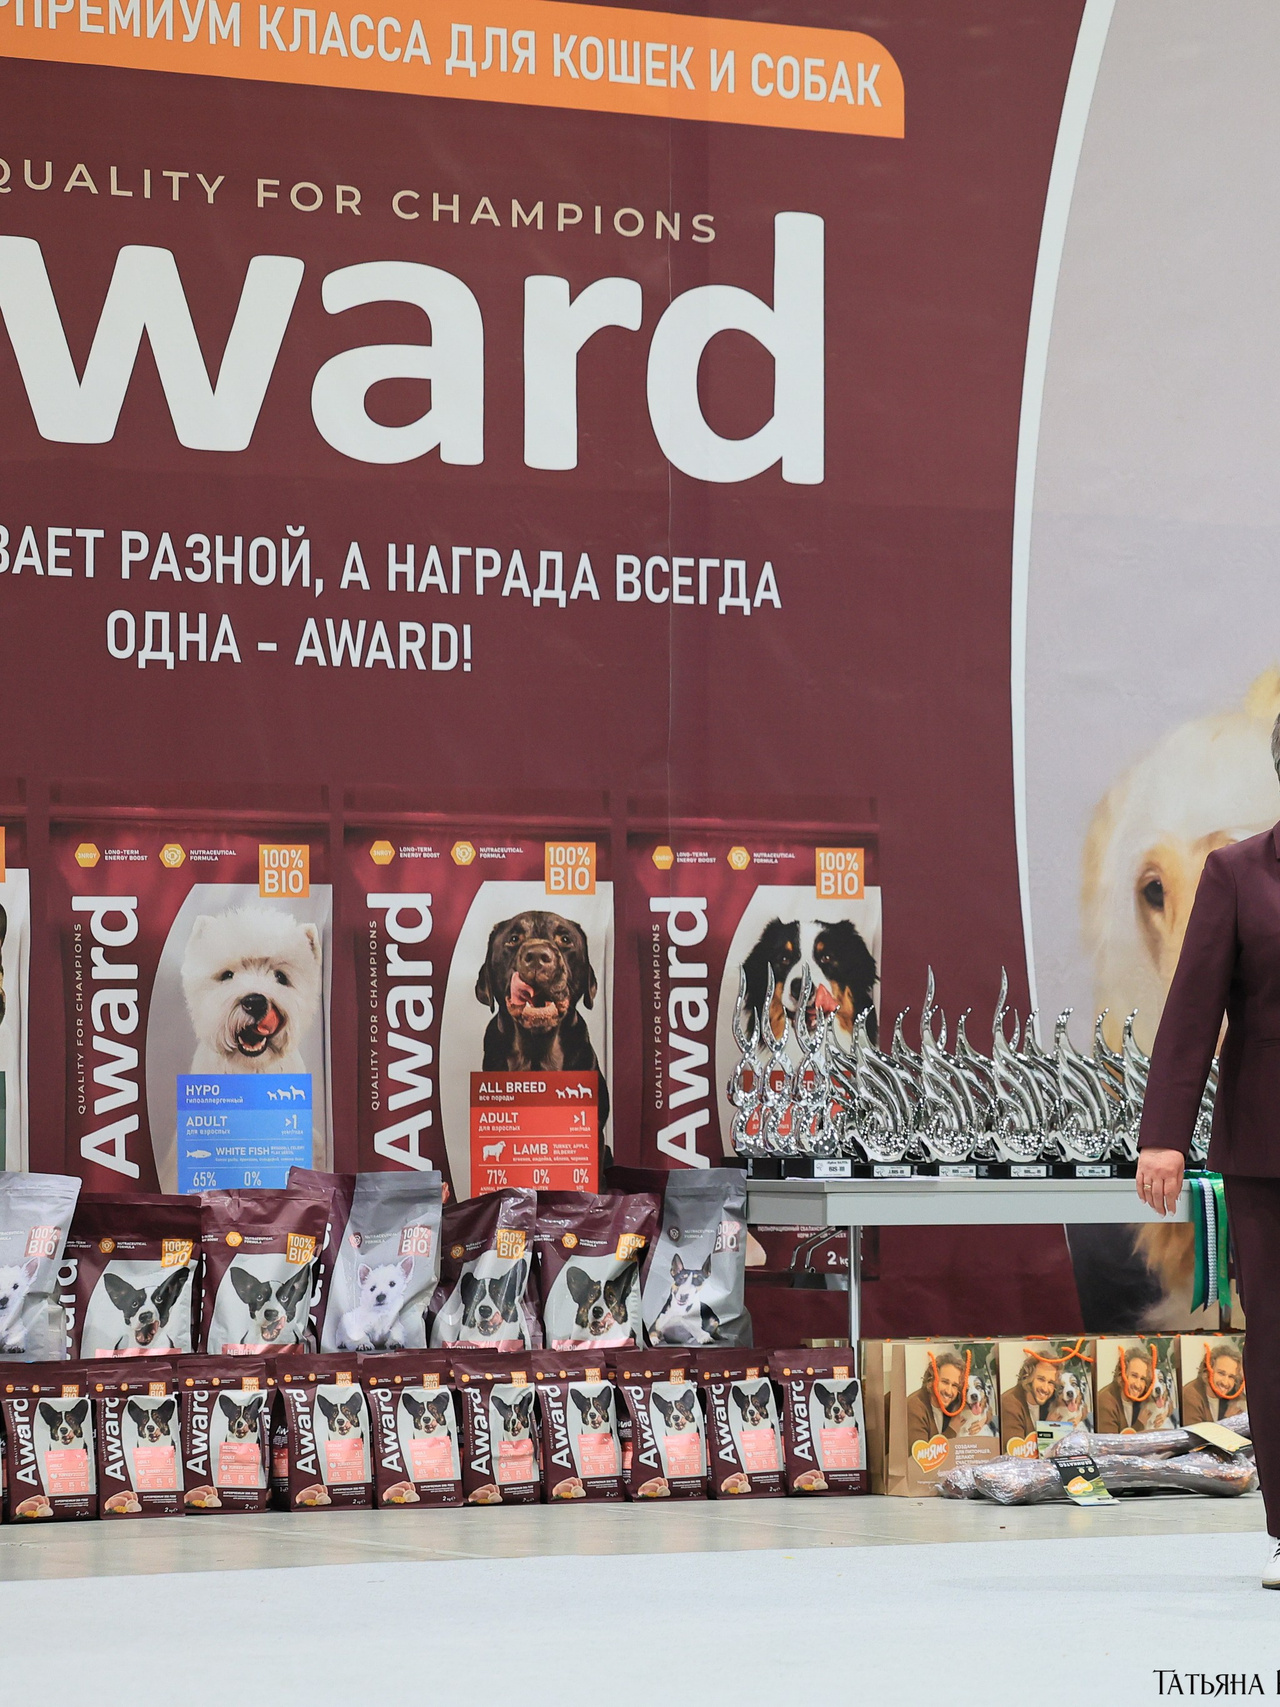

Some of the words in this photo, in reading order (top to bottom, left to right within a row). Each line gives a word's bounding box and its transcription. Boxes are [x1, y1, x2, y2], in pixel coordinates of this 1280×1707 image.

[0, 0, 240, 47] ПРЕМИУМ
[259, 5, 431, 65] КЛАССА
[445, 23, 536, 78] ДЛЯ
[552, 33, 695, 90] КОШЕК
[710, 48, 735, 93] И
[751, 52, 882, 107] СОБАК
[257, 178, 362, 216] FOR
[391, 189, 716, 243] CHAMPIONS
[121, 525, 323, 597] РАЗНОЙ,
[339, 544, 370, 592] А
[388, 544, 600, 608] НАГРАДА
[616, 554, 782, 616] ВСЕГДА
[106, 610, 242, 670] ОДНА
[294, 618, 473, 673] AWARD!
[262, 849, 304, 869] 100%
[549, 846, 591, 866] 100%
[819, 852, 859, 871] 100%
[264, 870, 303, 893] BIO
[550, 867, 590, 890] BIO
[820, 872, 859, 896] BIO
[74, 923, 83, 1012] CHAMPIONS
[369, 920, 378, 1009] CHAMPIONS
[652, 923, 661, 1010] CHAMPIONS
[71, 895, 140, 1179] Award
[76, 1017, 84, 1046] FOR
[366, 892, 434, 1171] Award
[370, 1013, 378, 1043] FOR
[649, 896, 710, 1168] Award
[654, 1013, 662, 1043] FOR
[77, 1053, 87, 1114] QUALITY
[371, 1050, 379, 1111] QUALITY
[479, 1081, 502, 1094] ALL
[505, 1081, 547, 1094] BREED
[655, 1049, 663, 1109] QUALITY
[185, 1084, 220, 1096] HYPO
[186, 1115, 228, 1127] ADULT
[479, 1112, 519, 1124] ADULT
[215, 1146, 246, 1156] WHITE
[248, 1146, 270, 1156] FISH
[513, 1143, 549, 1155] LAMB
[192, 1171, 217, 1187] 65%
[243, 1171, 262, 1187] 0%
[486, 1169, 508, 1184] 71%
[533, 1168, 550, 1184] 0%
[573, 1168, 590, 1184] 0%
[30, 1227, 58, 1240] 100%
[289, 1235, 314, 1249] 100%
[403, 1227, 429, 1240] 100%
[500, 1231, 523, 1244] 100%
[715, 1234, 737, 1251] BIO
[27, 1240, 56, 1256] BIO
[164, 1239, 192, 1253] 100%
[289, 1247, 310, 1262] BIO
[401, 1239, 429, 1254] BIO
[500, 1243, 522, 1257] BIO
[163, 1252, 189, 1266] BIO
[827, 1251, 838, 1265] 2
[284, 1388, 317, 1476] Award
[369, 1387, 403, 1473] Award
[463, 1387, 491, 1476] Award
[537, 1384, 572, 1469] Award
[623, 1385, 659, 1469] Award
[917, 1442, 948, 1461] МНЯМС
